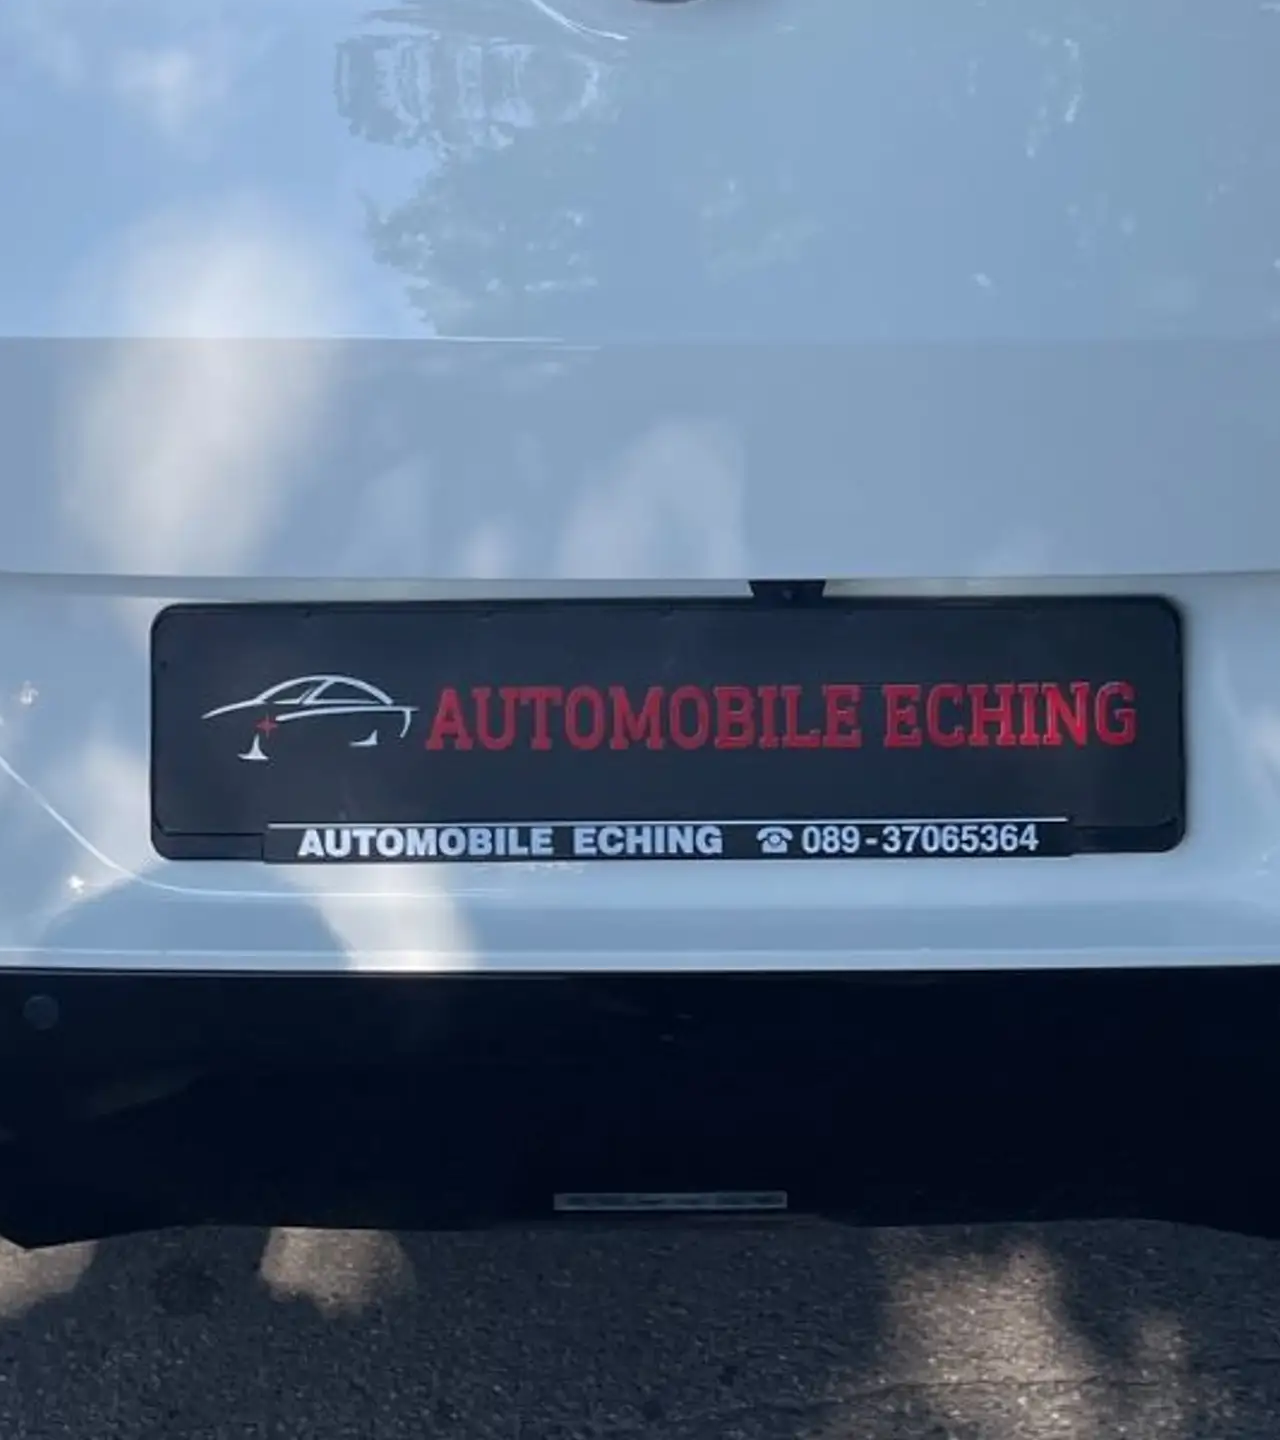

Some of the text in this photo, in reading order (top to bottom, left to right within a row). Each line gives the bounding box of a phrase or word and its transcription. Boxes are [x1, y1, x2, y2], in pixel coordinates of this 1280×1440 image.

[424, 681, 1138, 751] AUTOMOBILE ECHING
[297, 824, 1039, 857] AUTOMOBILE ECHING 089-37065364
